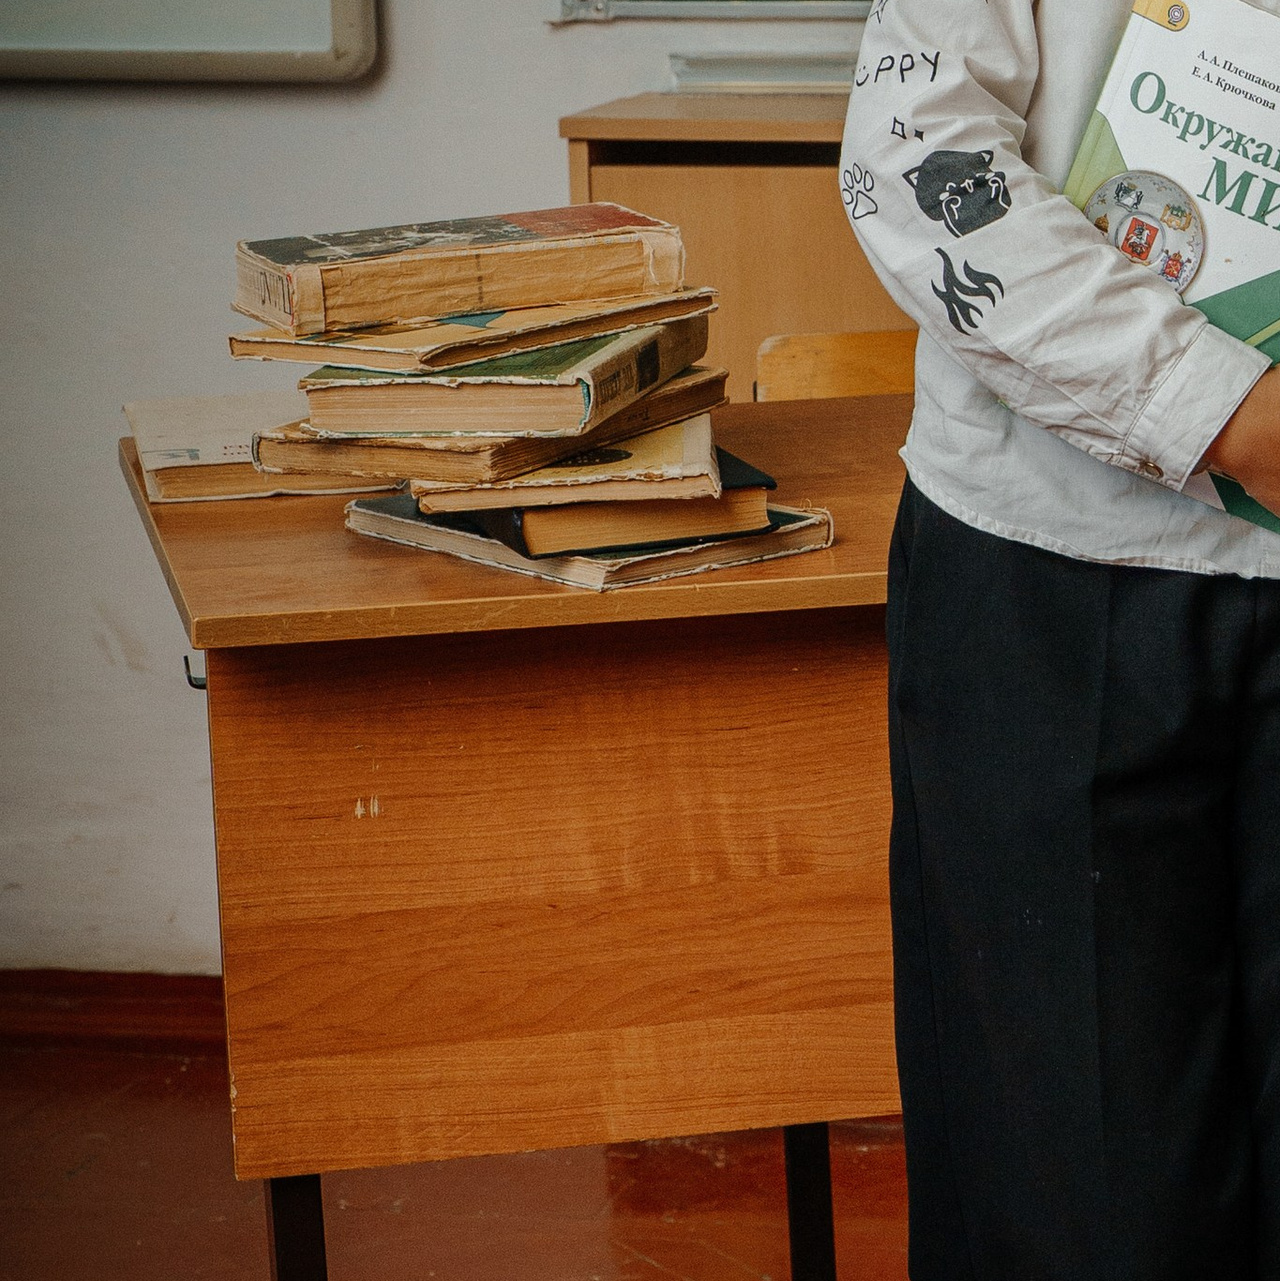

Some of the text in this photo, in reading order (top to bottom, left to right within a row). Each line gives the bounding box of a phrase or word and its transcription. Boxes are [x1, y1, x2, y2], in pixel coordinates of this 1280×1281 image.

[1197, 50, 1208, 62] А.
[1209, 55, 1220, 67] А.
[1191, 65, 1277, 111] Е. А. Крючкова
